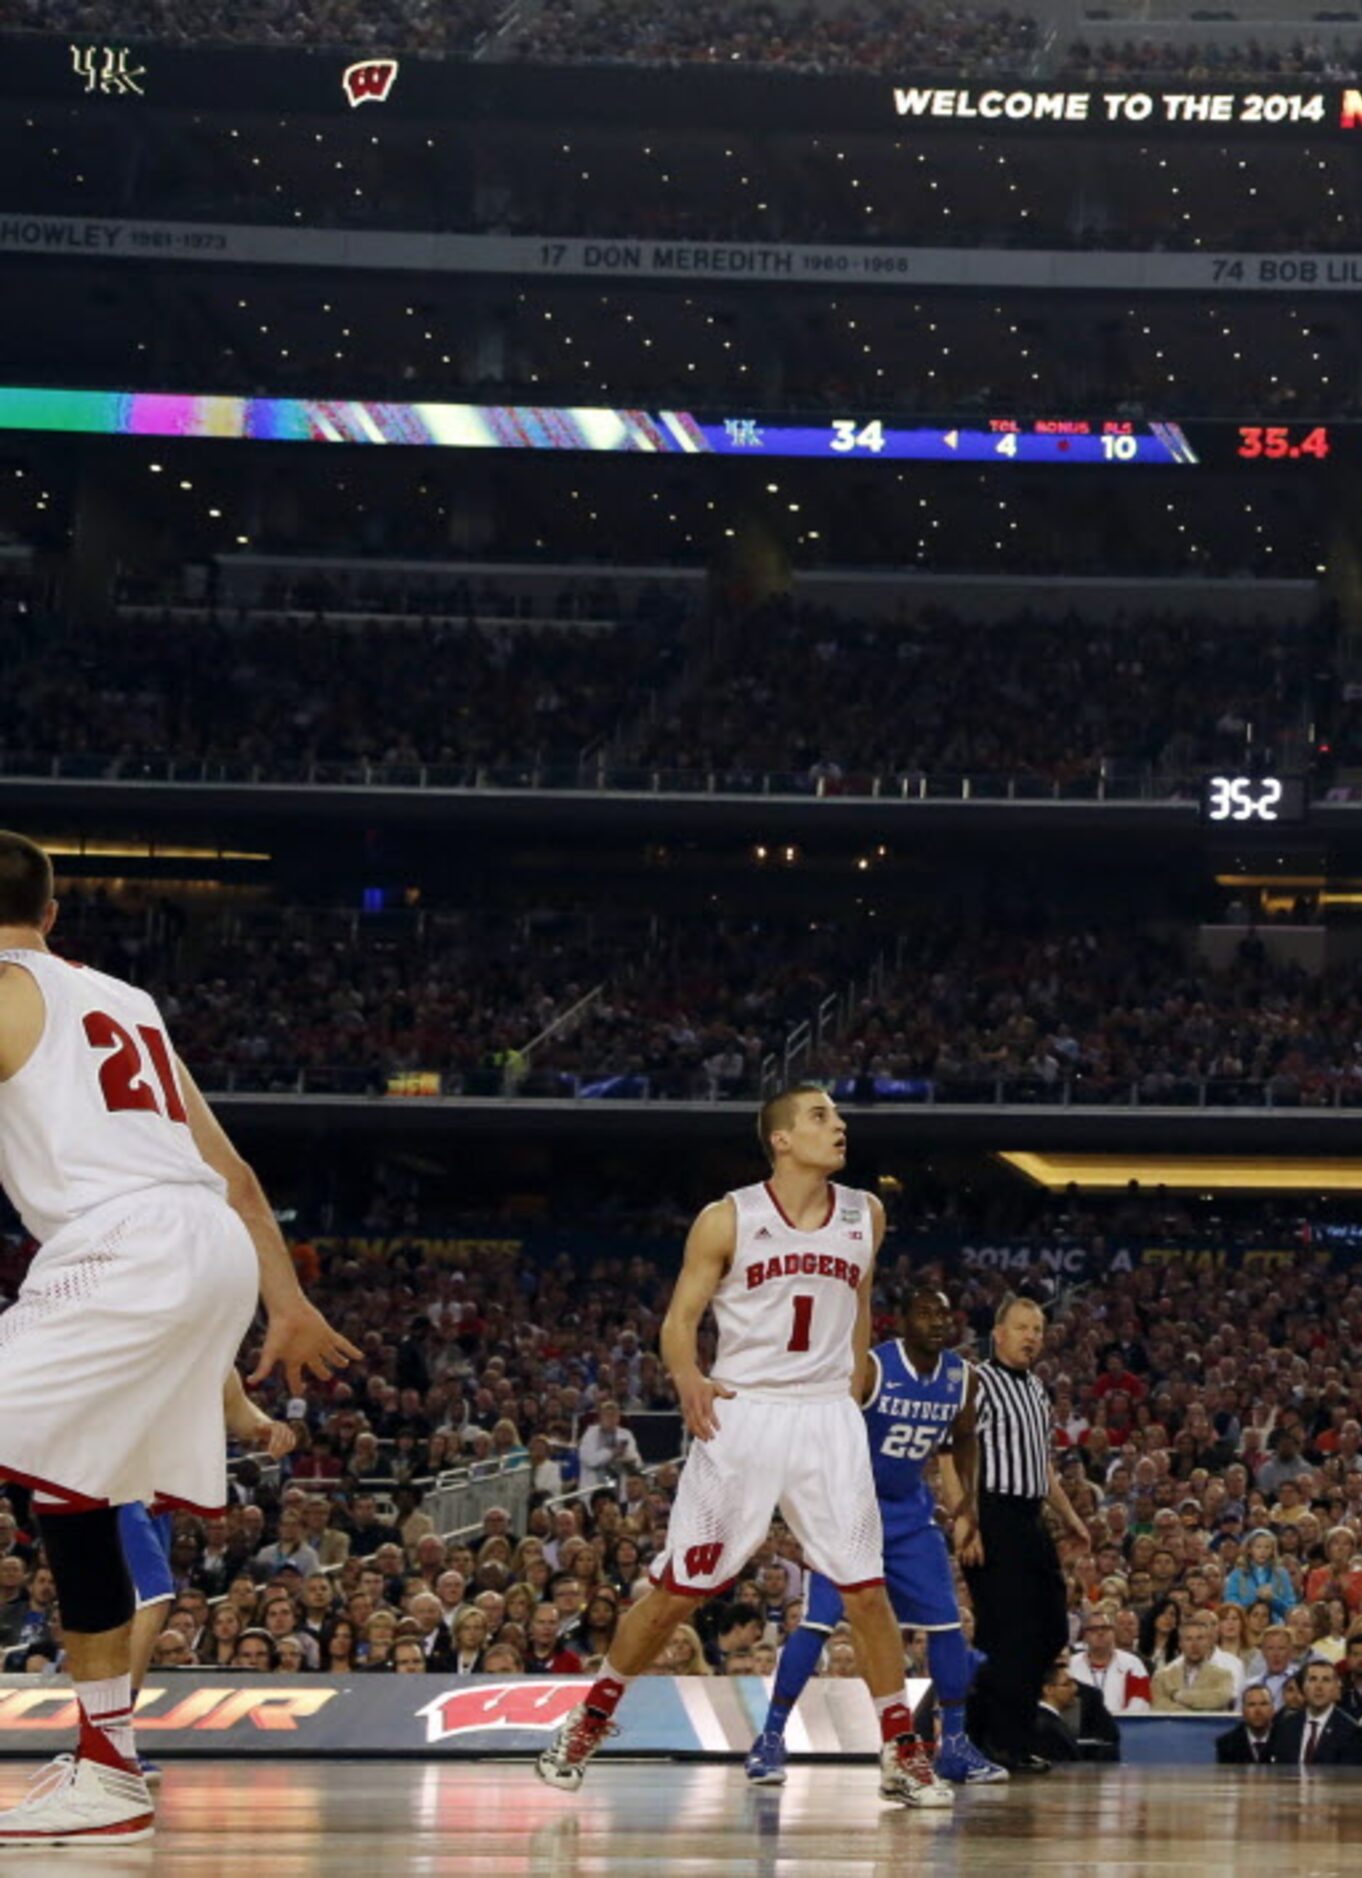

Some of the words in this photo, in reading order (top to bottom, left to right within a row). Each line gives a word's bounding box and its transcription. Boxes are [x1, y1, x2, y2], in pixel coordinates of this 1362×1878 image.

[893, 87, 1090, 121] WELCOME
[1103, 93, 1153, 122] TO
[1162, 93, 1234, 123] THE
[1239, 93, 1325, 123] 2014
[1, 220, 122, 248] HOWLEY
[541, 245, 568, 267] 17
[583, 246, 642, 269] DON
[652, 248, 793, 273] MEREDITH
[1211, 259, 1245, 283] 74
[1258, 259, 1319, 284] BOB
[829, 419, 886, 453] 34
[995, 432, 1018, 459] 4
[1100, 435, 1138, 461] 10
[1237, 426, 1330, 459] 35.4
[81, 1009, 189, 1125] 21
[746, 1251, 862, 1292] BADGERS
[959, 1246, 1034, 1271] 2014
[1039, 1247, 1134, 1273] NCA
[787, 1294, 815, 1353] 1
[879, 1422, 939, 1461] 25
[0, 1688, 338, 1730] OUR
